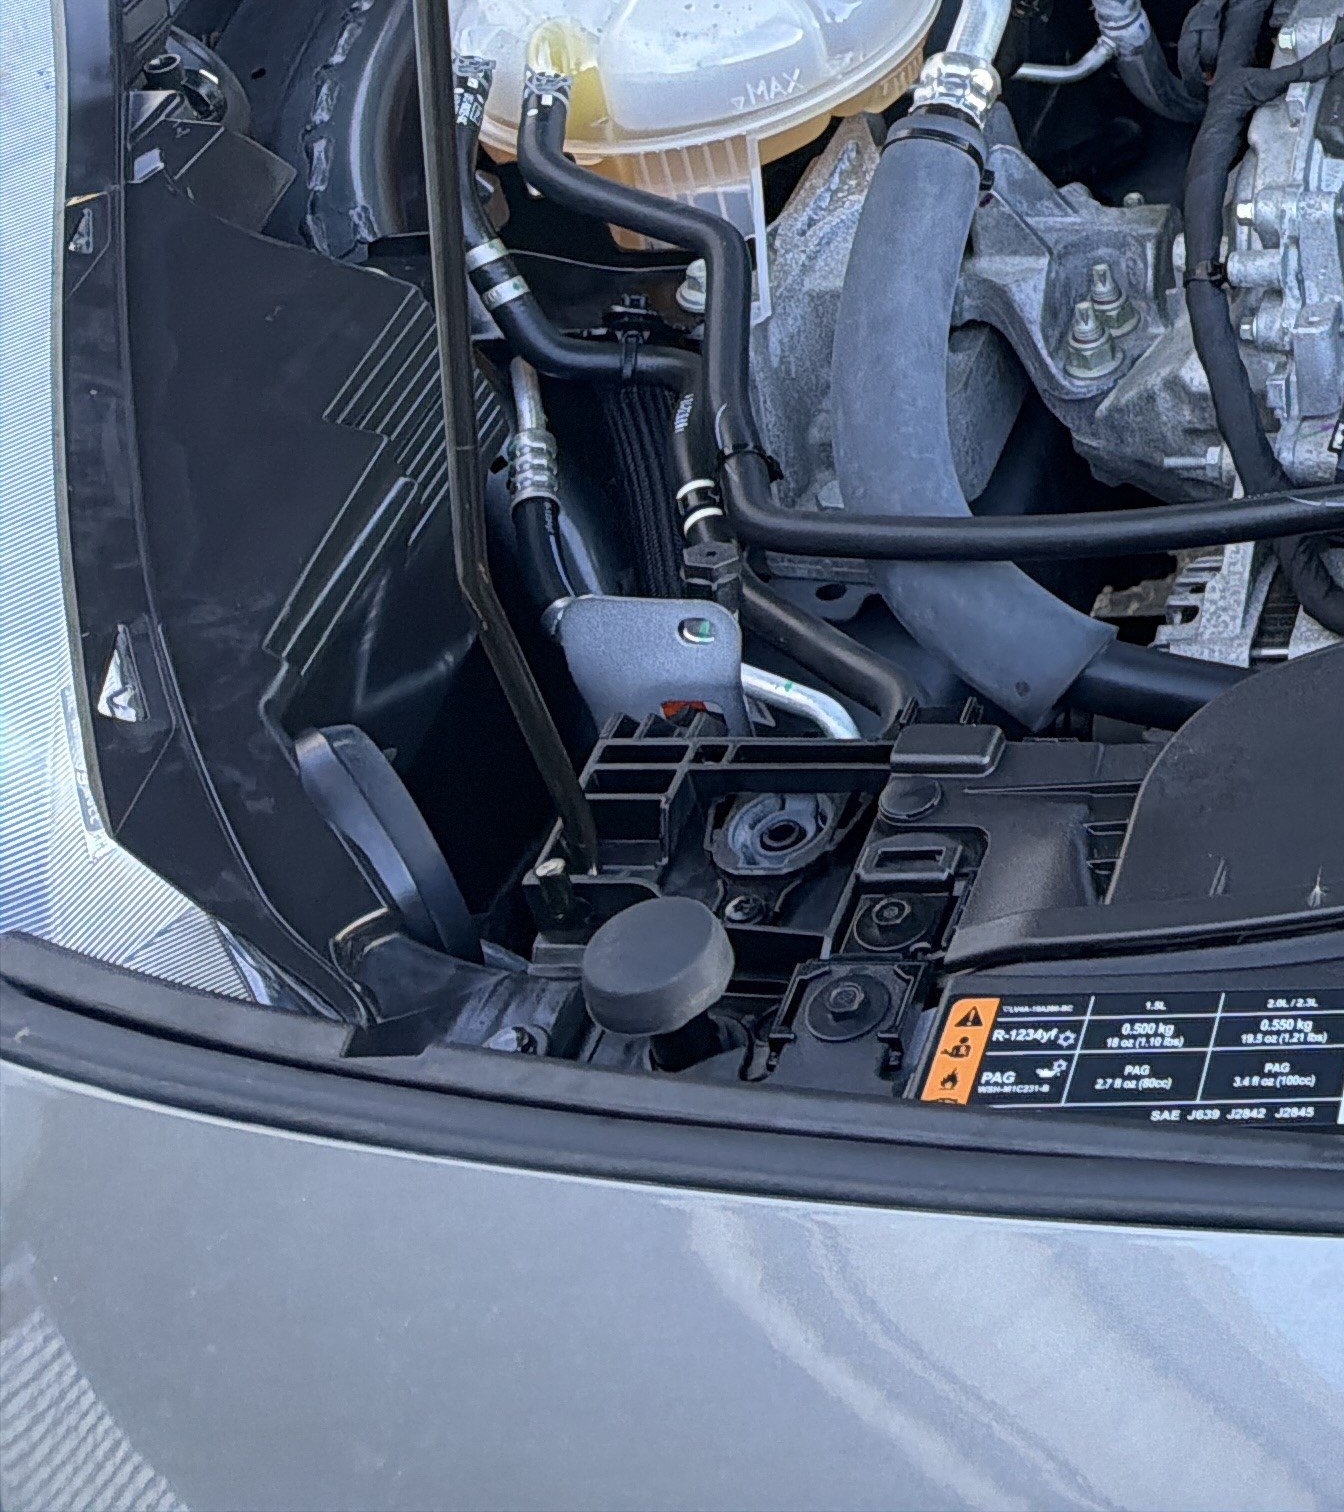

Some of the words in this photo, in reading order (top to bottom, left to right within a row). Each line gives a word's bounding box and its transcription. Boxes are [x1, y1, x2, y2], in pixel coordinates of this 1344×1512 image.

[746, 68, 800, 105] MAX
[1121, 1022, 1156, 1036] 0.500
[1158, 1022, 1175, 1037] kg
[1260, 1018, 1295, 1031] 0.550
[1296, 1018, 1313, 1033] kg
[992, 1028, 1059, 1044] R-1234yf
[1120, 1039, 1134, 1048] oz
[1135, 1036, 1162, 1048] (1.10
[1264, 1034, 1278, 1044] oz
[1278, 1032, 1305, 1044] (1.21
[1123, 1064, 1151, 1076] PAG
[1263, 1062, 1291, 1074] PAG
[981, 1071, 1016, 1084] PAG
[1260, 1077, 1275, 1087] oz
[1275, 1074, 1316, 1088] (100cc)
[1123, 1080, 1137, 1089] oz
[1151, 1110, 1180, 1122] SAE
[1187, 1109, 1221, 1121] J639
[1226, 1108, 1267, 1120] J2842
